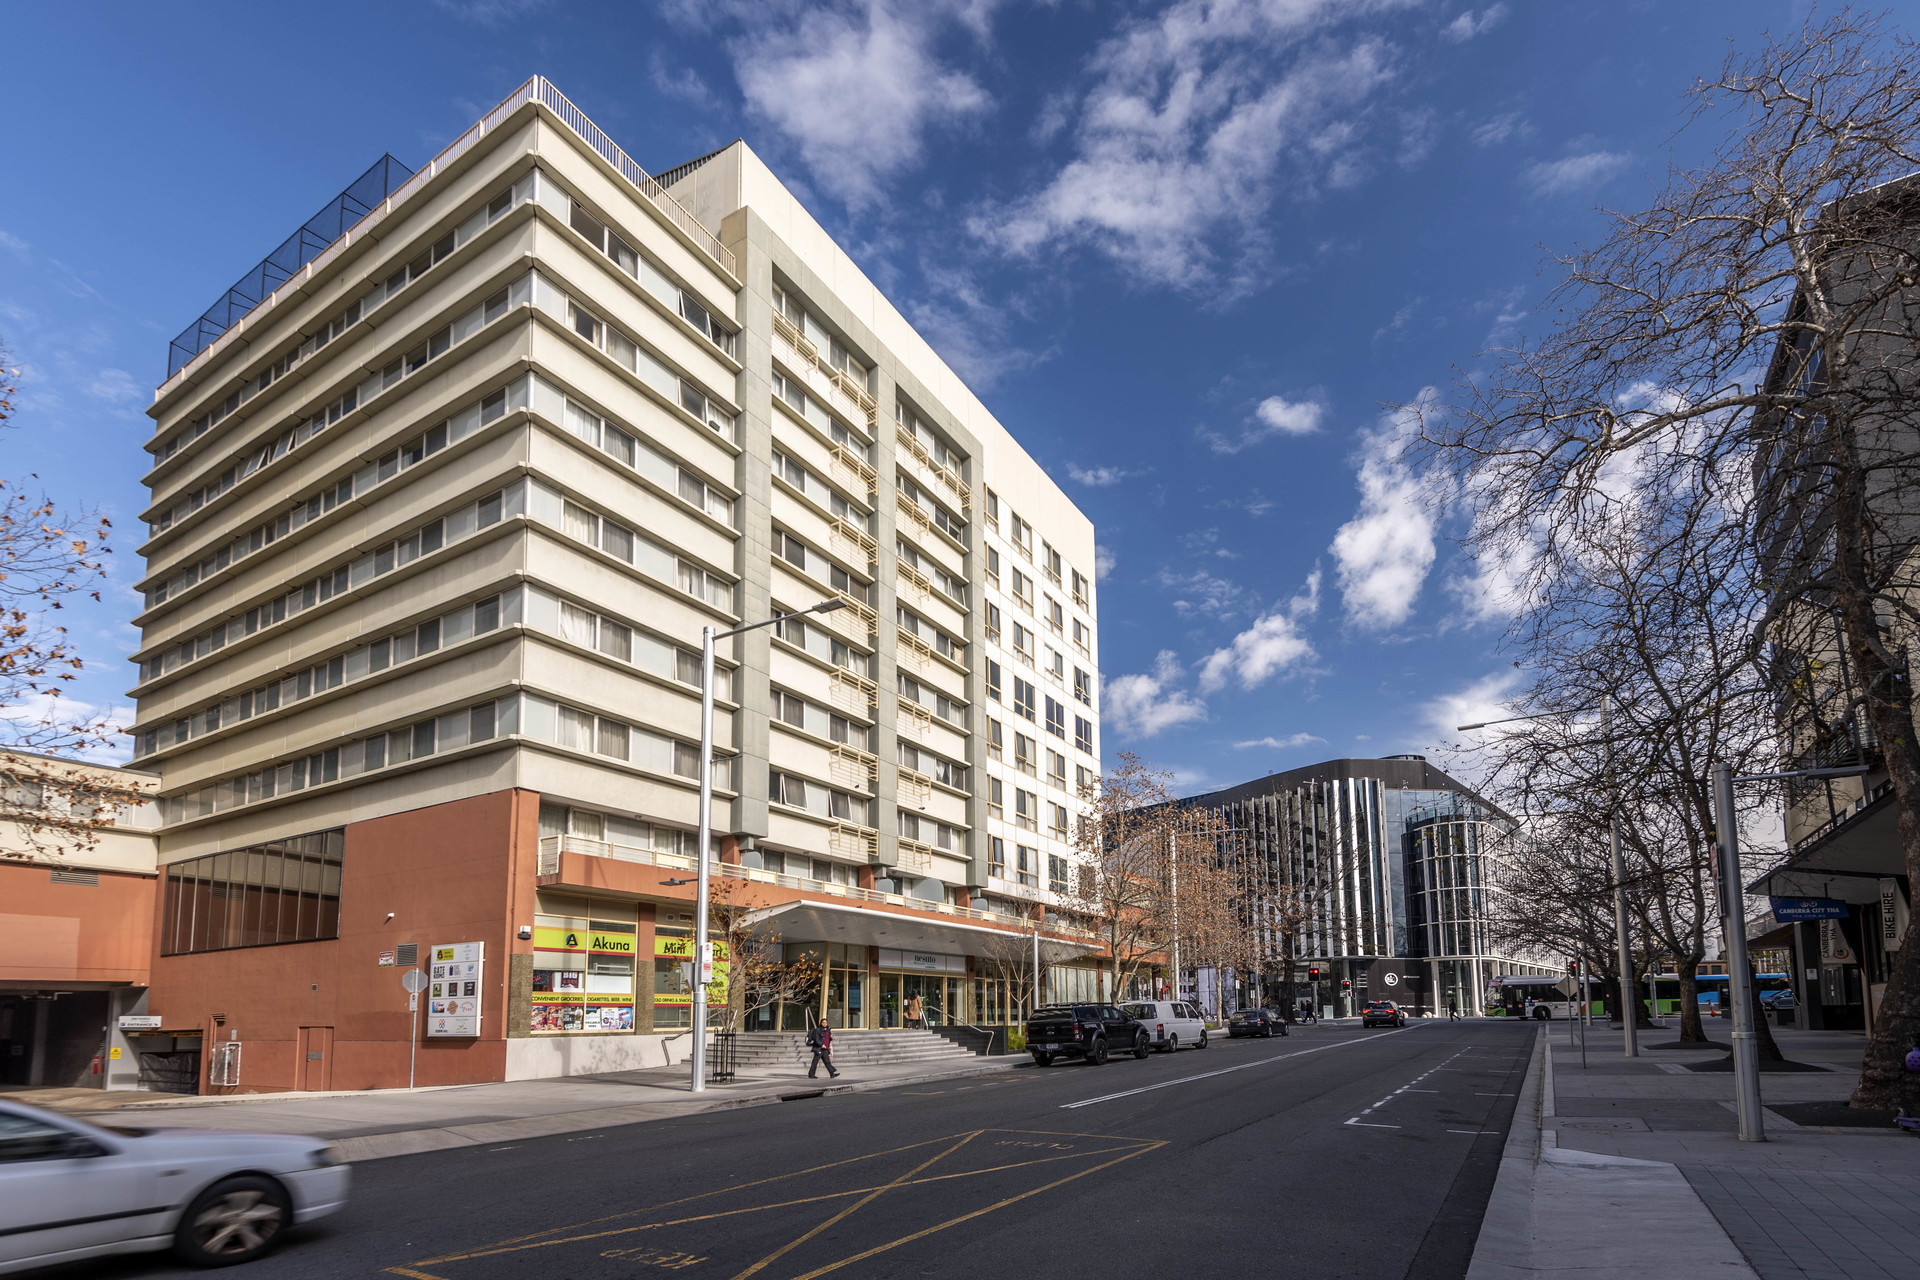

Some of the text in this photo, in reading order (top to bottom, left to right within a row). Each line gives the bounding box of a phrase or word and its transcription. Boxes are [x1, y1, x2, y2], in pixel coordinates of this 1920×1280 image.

[1883, 892, 1896, 939] BIKE HIRE
[592, 936, 630, 951] Akuna
[1821, 925, 1830, 959] CANBERRA
[1829, 927, 1837, 941] YHA
